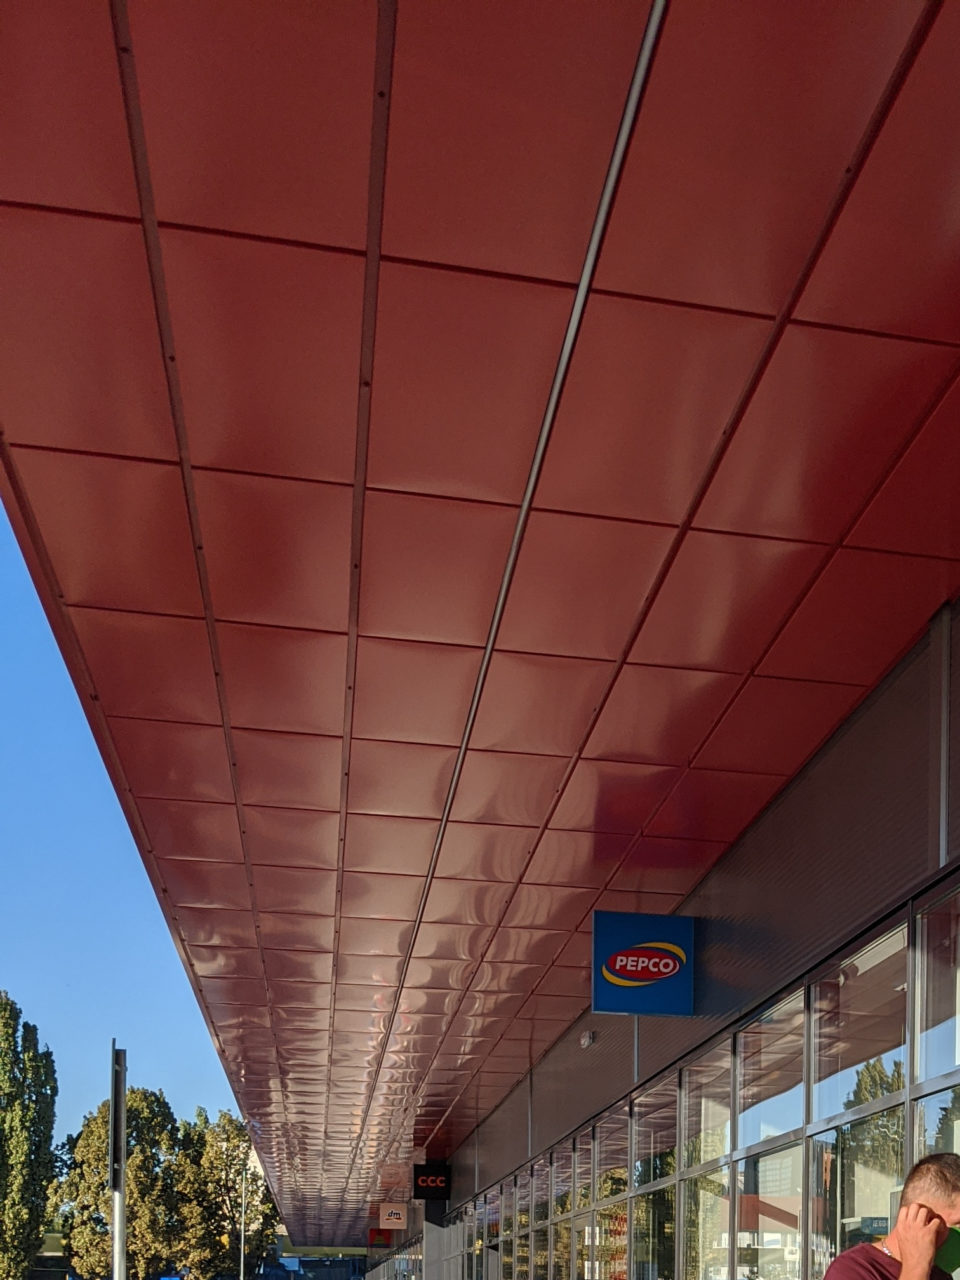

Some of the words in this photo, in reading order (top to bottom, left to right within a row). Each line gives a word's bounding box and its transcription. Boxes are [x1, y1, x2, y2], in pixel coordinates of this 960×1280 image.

[615, 956, 674, 973] PEPCO
[418, 1176, 446, 1187] CCC
[387, 1210, 401, 1218] dm
